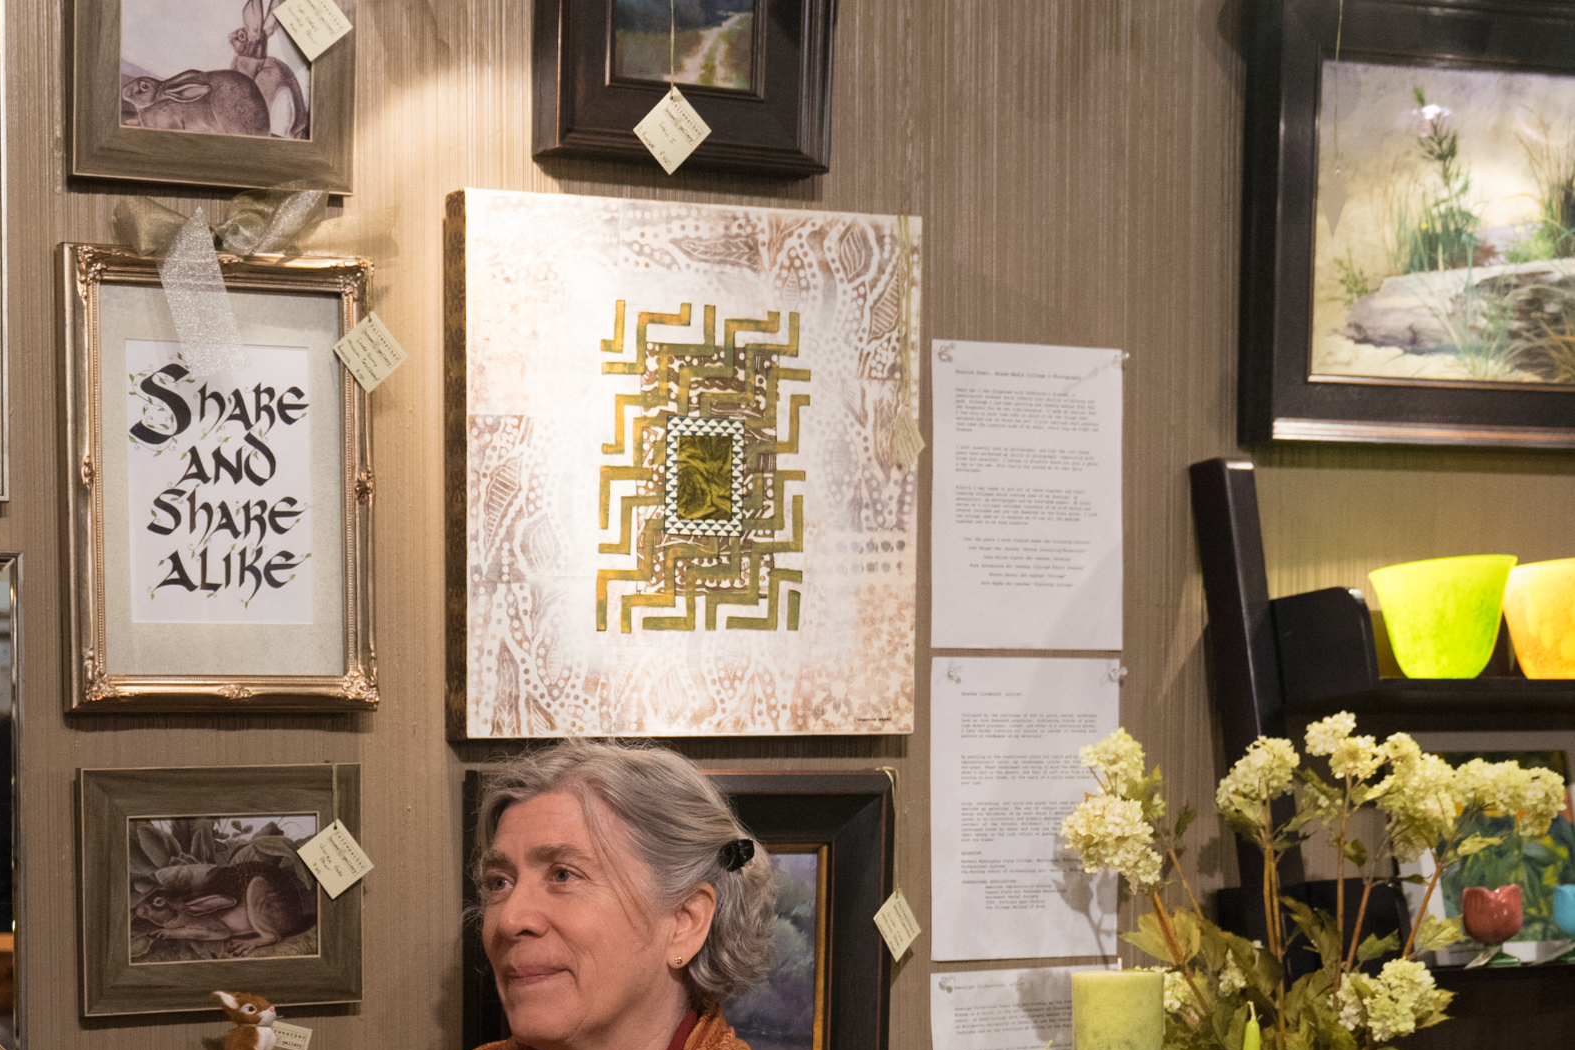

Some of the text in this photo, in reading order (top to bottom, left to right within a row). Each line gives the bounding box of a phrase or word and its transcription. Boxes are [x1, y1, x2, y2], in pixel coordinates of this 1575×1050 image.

[671, 99, 701, 136] fairweather
[677, 124, 694, 144] gallery
[369, 323, 399, 360] fairweather
[175, 432, 277, 486] AND
[335, 831, 364, 868] fairweather
[282, 1040, 303, 1049] gallery
